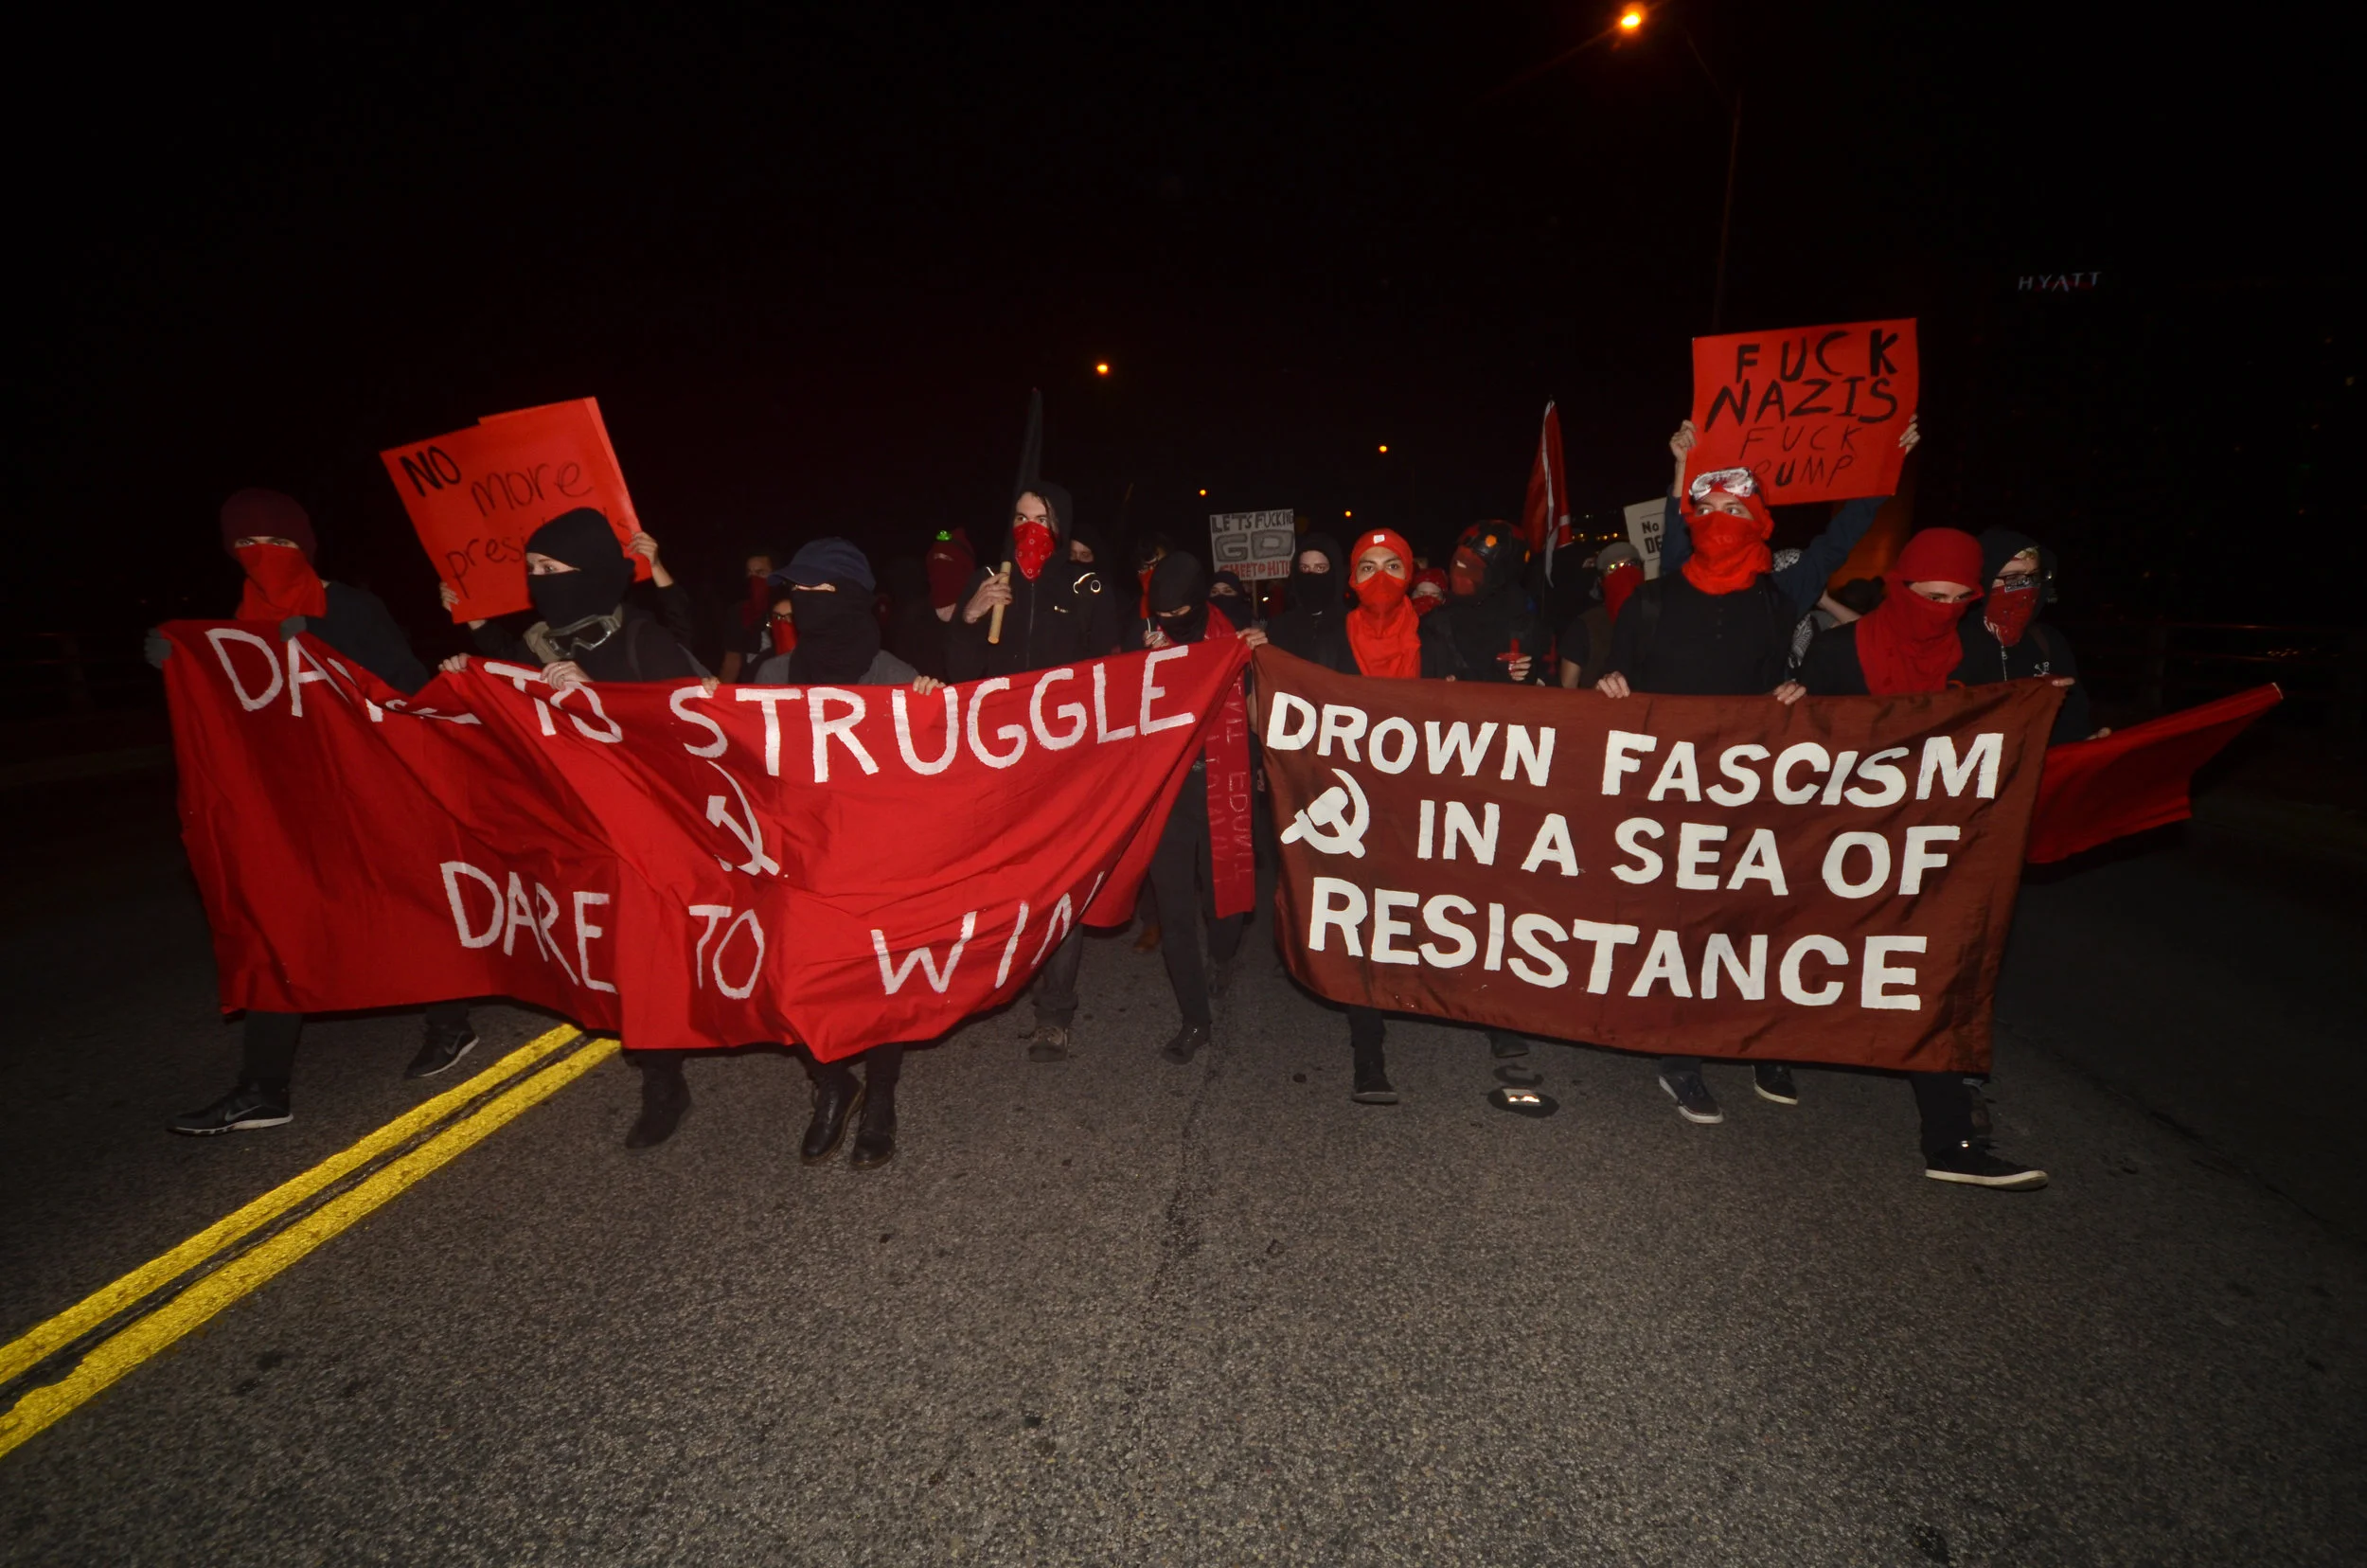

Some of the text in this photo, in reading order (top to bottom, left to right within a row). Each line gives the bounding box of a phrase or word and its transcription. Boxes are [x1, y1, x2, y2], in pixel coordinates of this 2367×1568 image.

[2018, 270, 2103, 294] HYATT
[1735, 329, 1898, 383] FUCK
[1704, 375, 1898, 433] NAZIS
[1738, 424, 1863, 460] FUCK
[399, 445, 462, 497] NO
[472, 462, 594, 517] more
[1215, 530, 1293, 562] GO
[1642, 521, 1659, 534] No
[484, 661, 623, 743] TO
[668, 645, 1196, 783] STRUGGLE
[1266, 691, 1556, 787] DROWN
[1601, 730, 2004, 808] FASCISM
[1417, 799, 1961, 900] IN A SEA OF
[439, 860, 618, 994] DARE
[689, 903, 765, 1000] TO
[1308, 877, 1928, 1011] RESISTANCE
